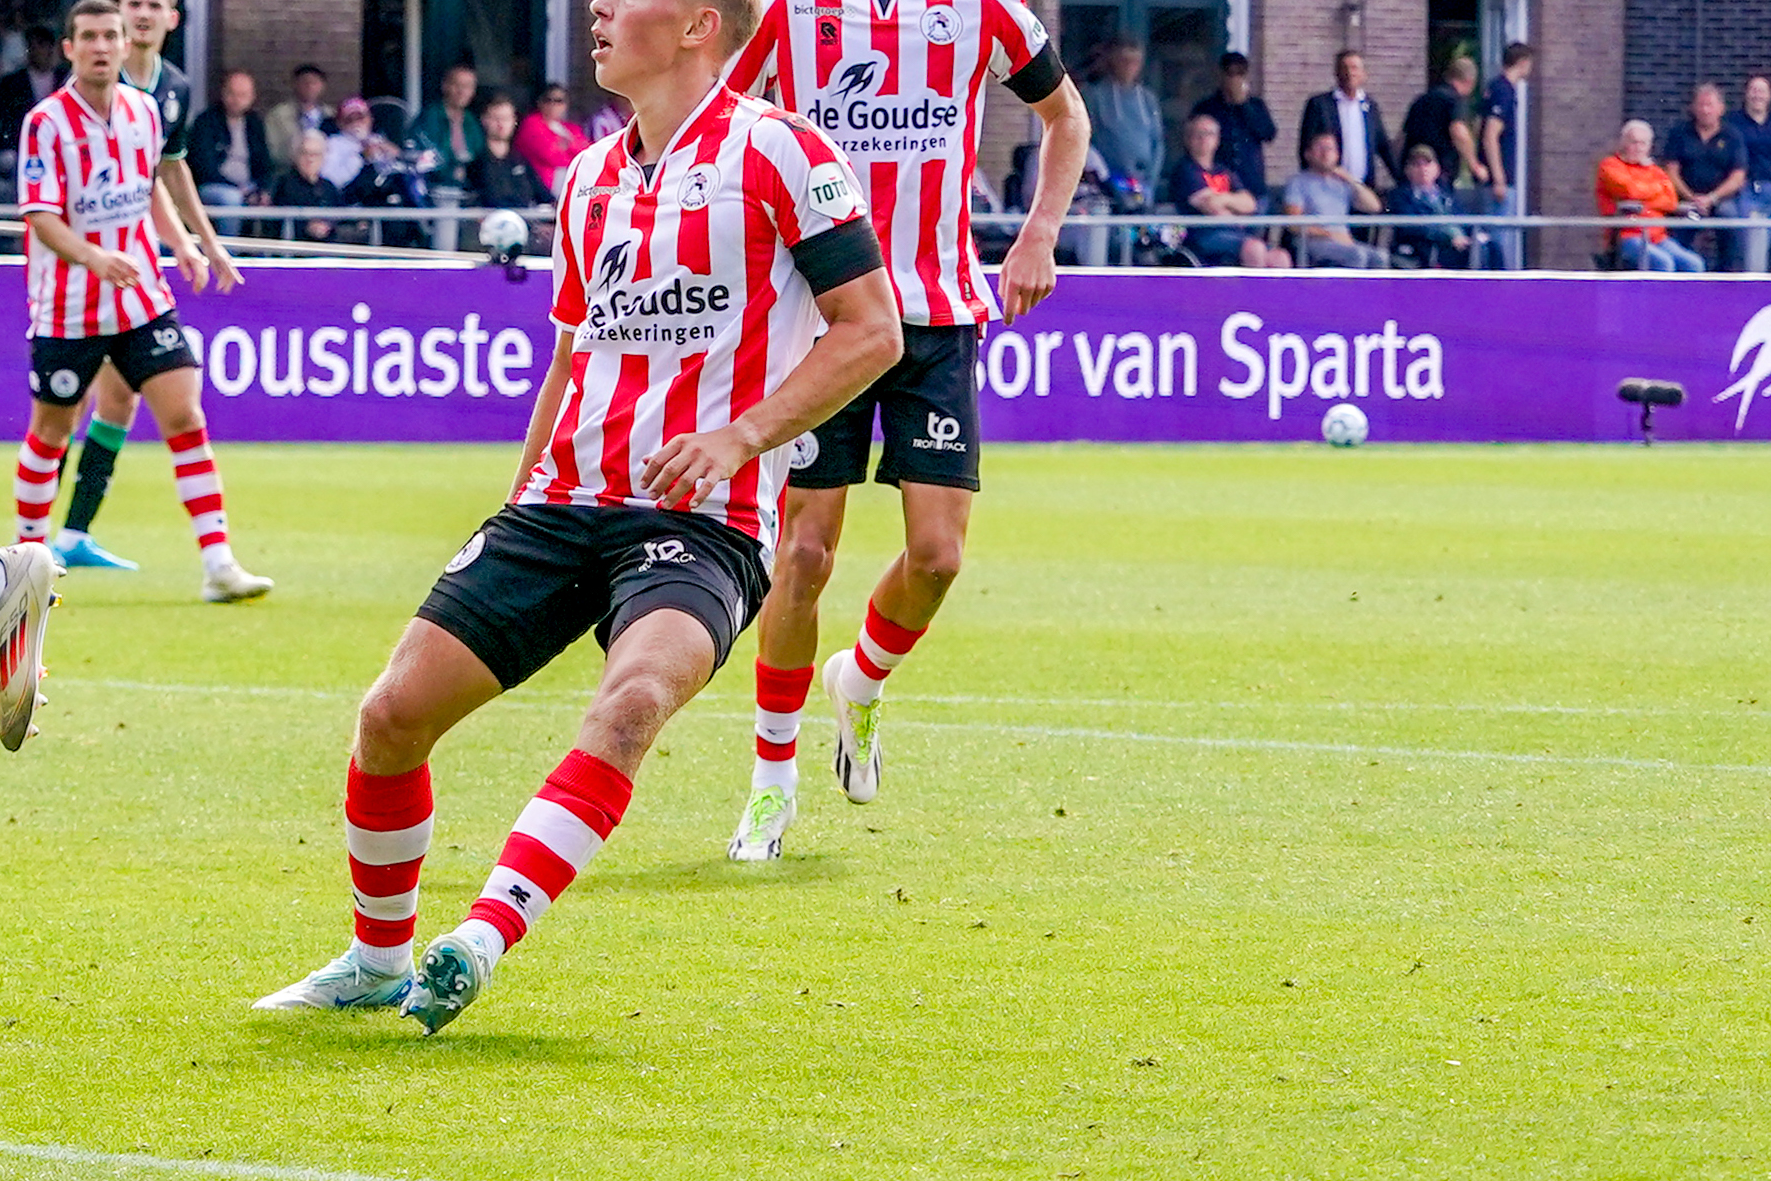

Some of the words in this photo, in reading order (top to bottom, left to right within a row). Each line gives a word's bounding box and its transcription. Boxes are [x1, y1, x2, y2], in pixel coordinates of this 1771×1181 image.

[807, 99, 840, 130] de
[847, 98, 958, 130] Goudse
[834, 136, 947, 152] rzekeringen
[812, 176, 848, 204] TOTO
[1074, 330, 1199, 399] van
[1219, 311, 1445, 421] Sparta
